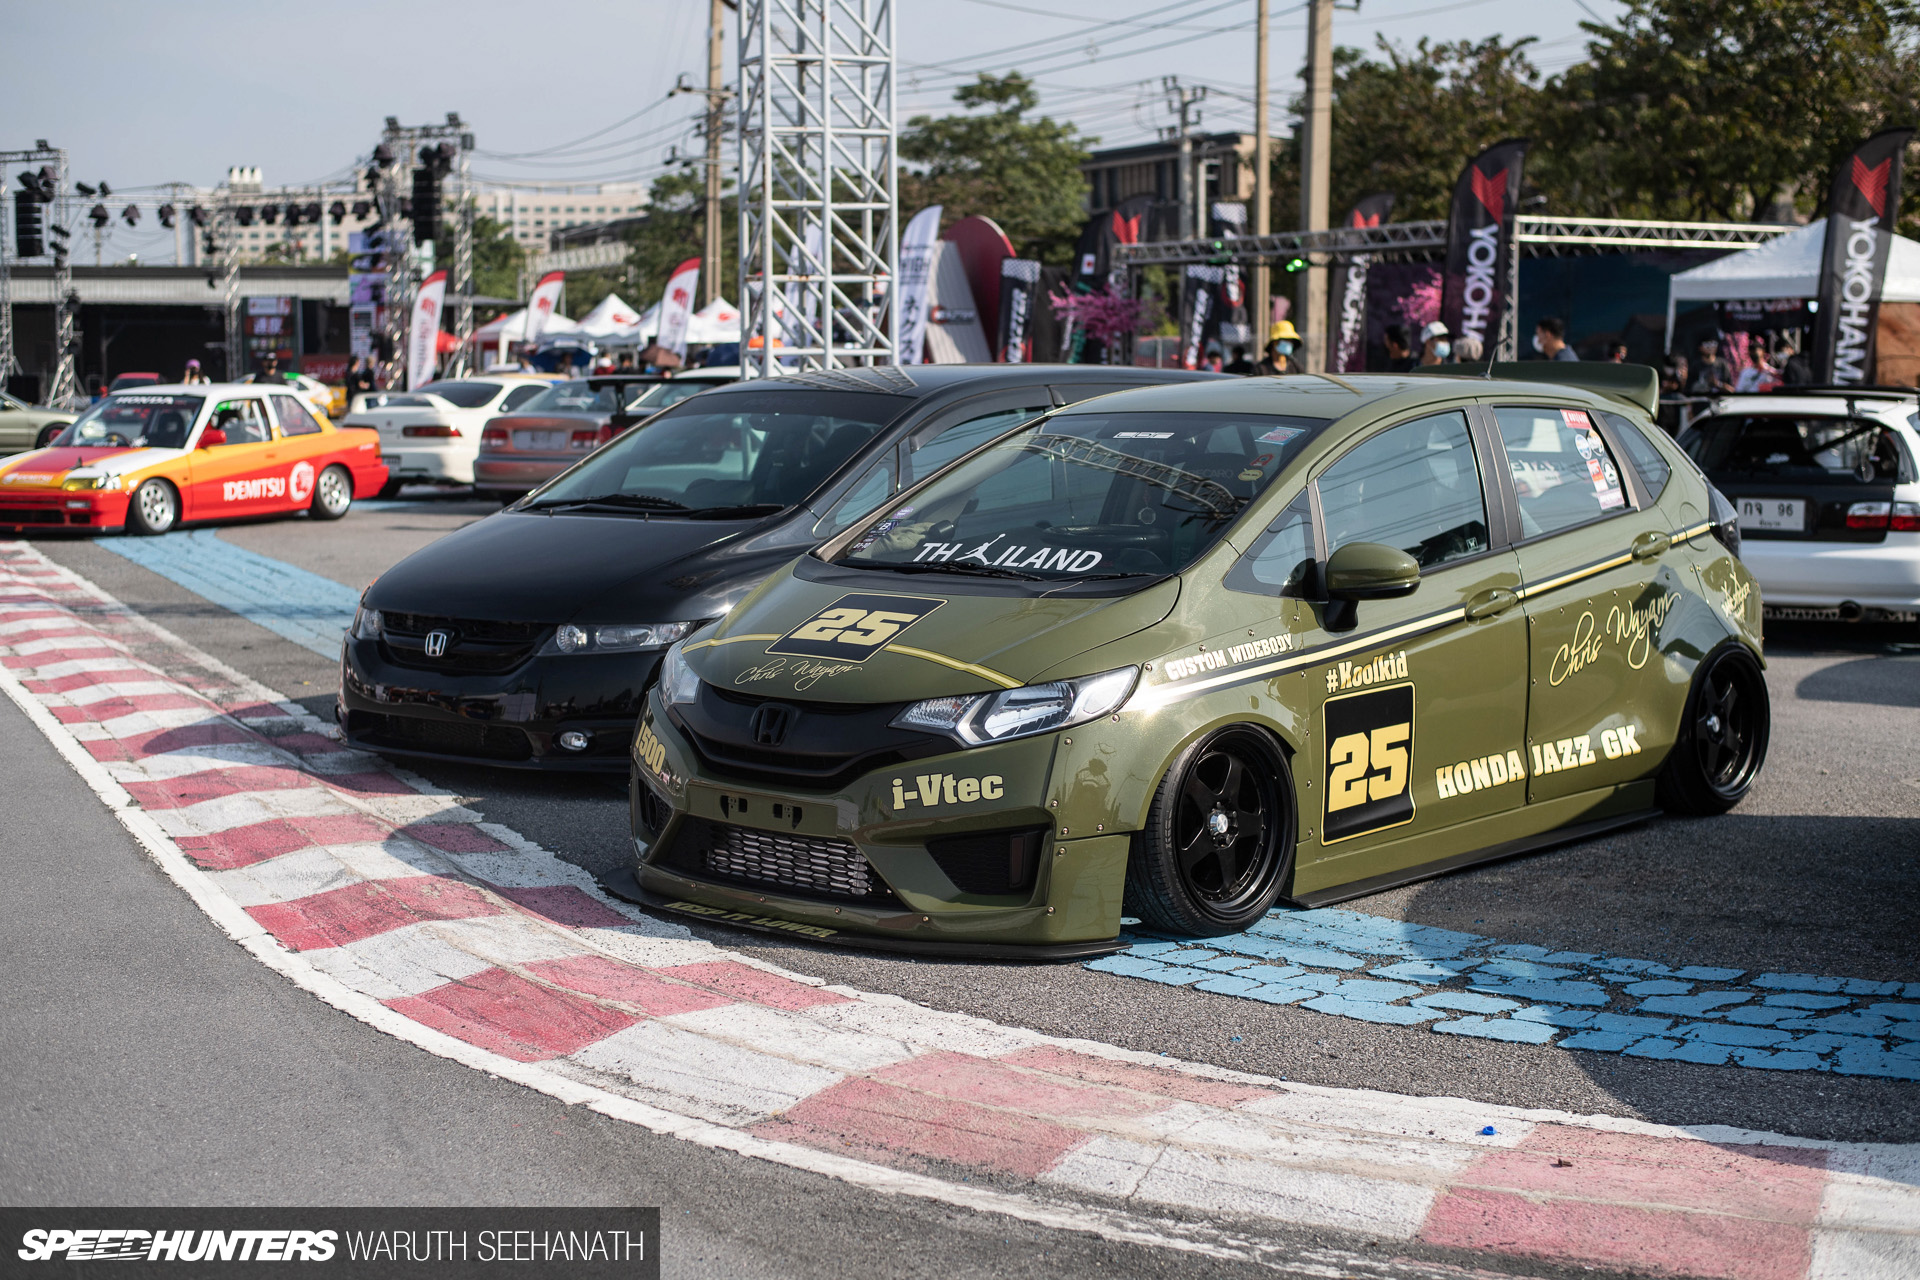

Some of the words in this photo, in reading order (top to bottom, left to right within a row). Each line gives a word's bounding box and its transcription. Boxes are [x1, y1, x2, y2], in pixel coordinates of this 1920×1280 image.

[116, 396, 174, 405] HONDA
[223, 477, 286, 502] IDEMITSU
[1778, 503, 1793, 516] 96
[788, 607, 920, 647] 25
[1164, 649, 1228, 681] CUSTOM
[1227, 632, 1294, 665] WIDEBODY
[1549, 610, 1603, 688] Chris
[734, 657, 787, 685] Chris
[1325, 650, 1409, 694] #Koolkid
[635, 720, 666, 775] 1500
[1328, 721, 1410, 813] 25
[1435, 749, 1526, 800] HONDA
[1531, 734, 1597, 777] JAZZ
[1600, 724, 1642, 761] GK
[892, 773, 1004, 810] i-Vtec
[664, 901, 728, 915] KEEP
[750, 917, 838, 938] LOWER
